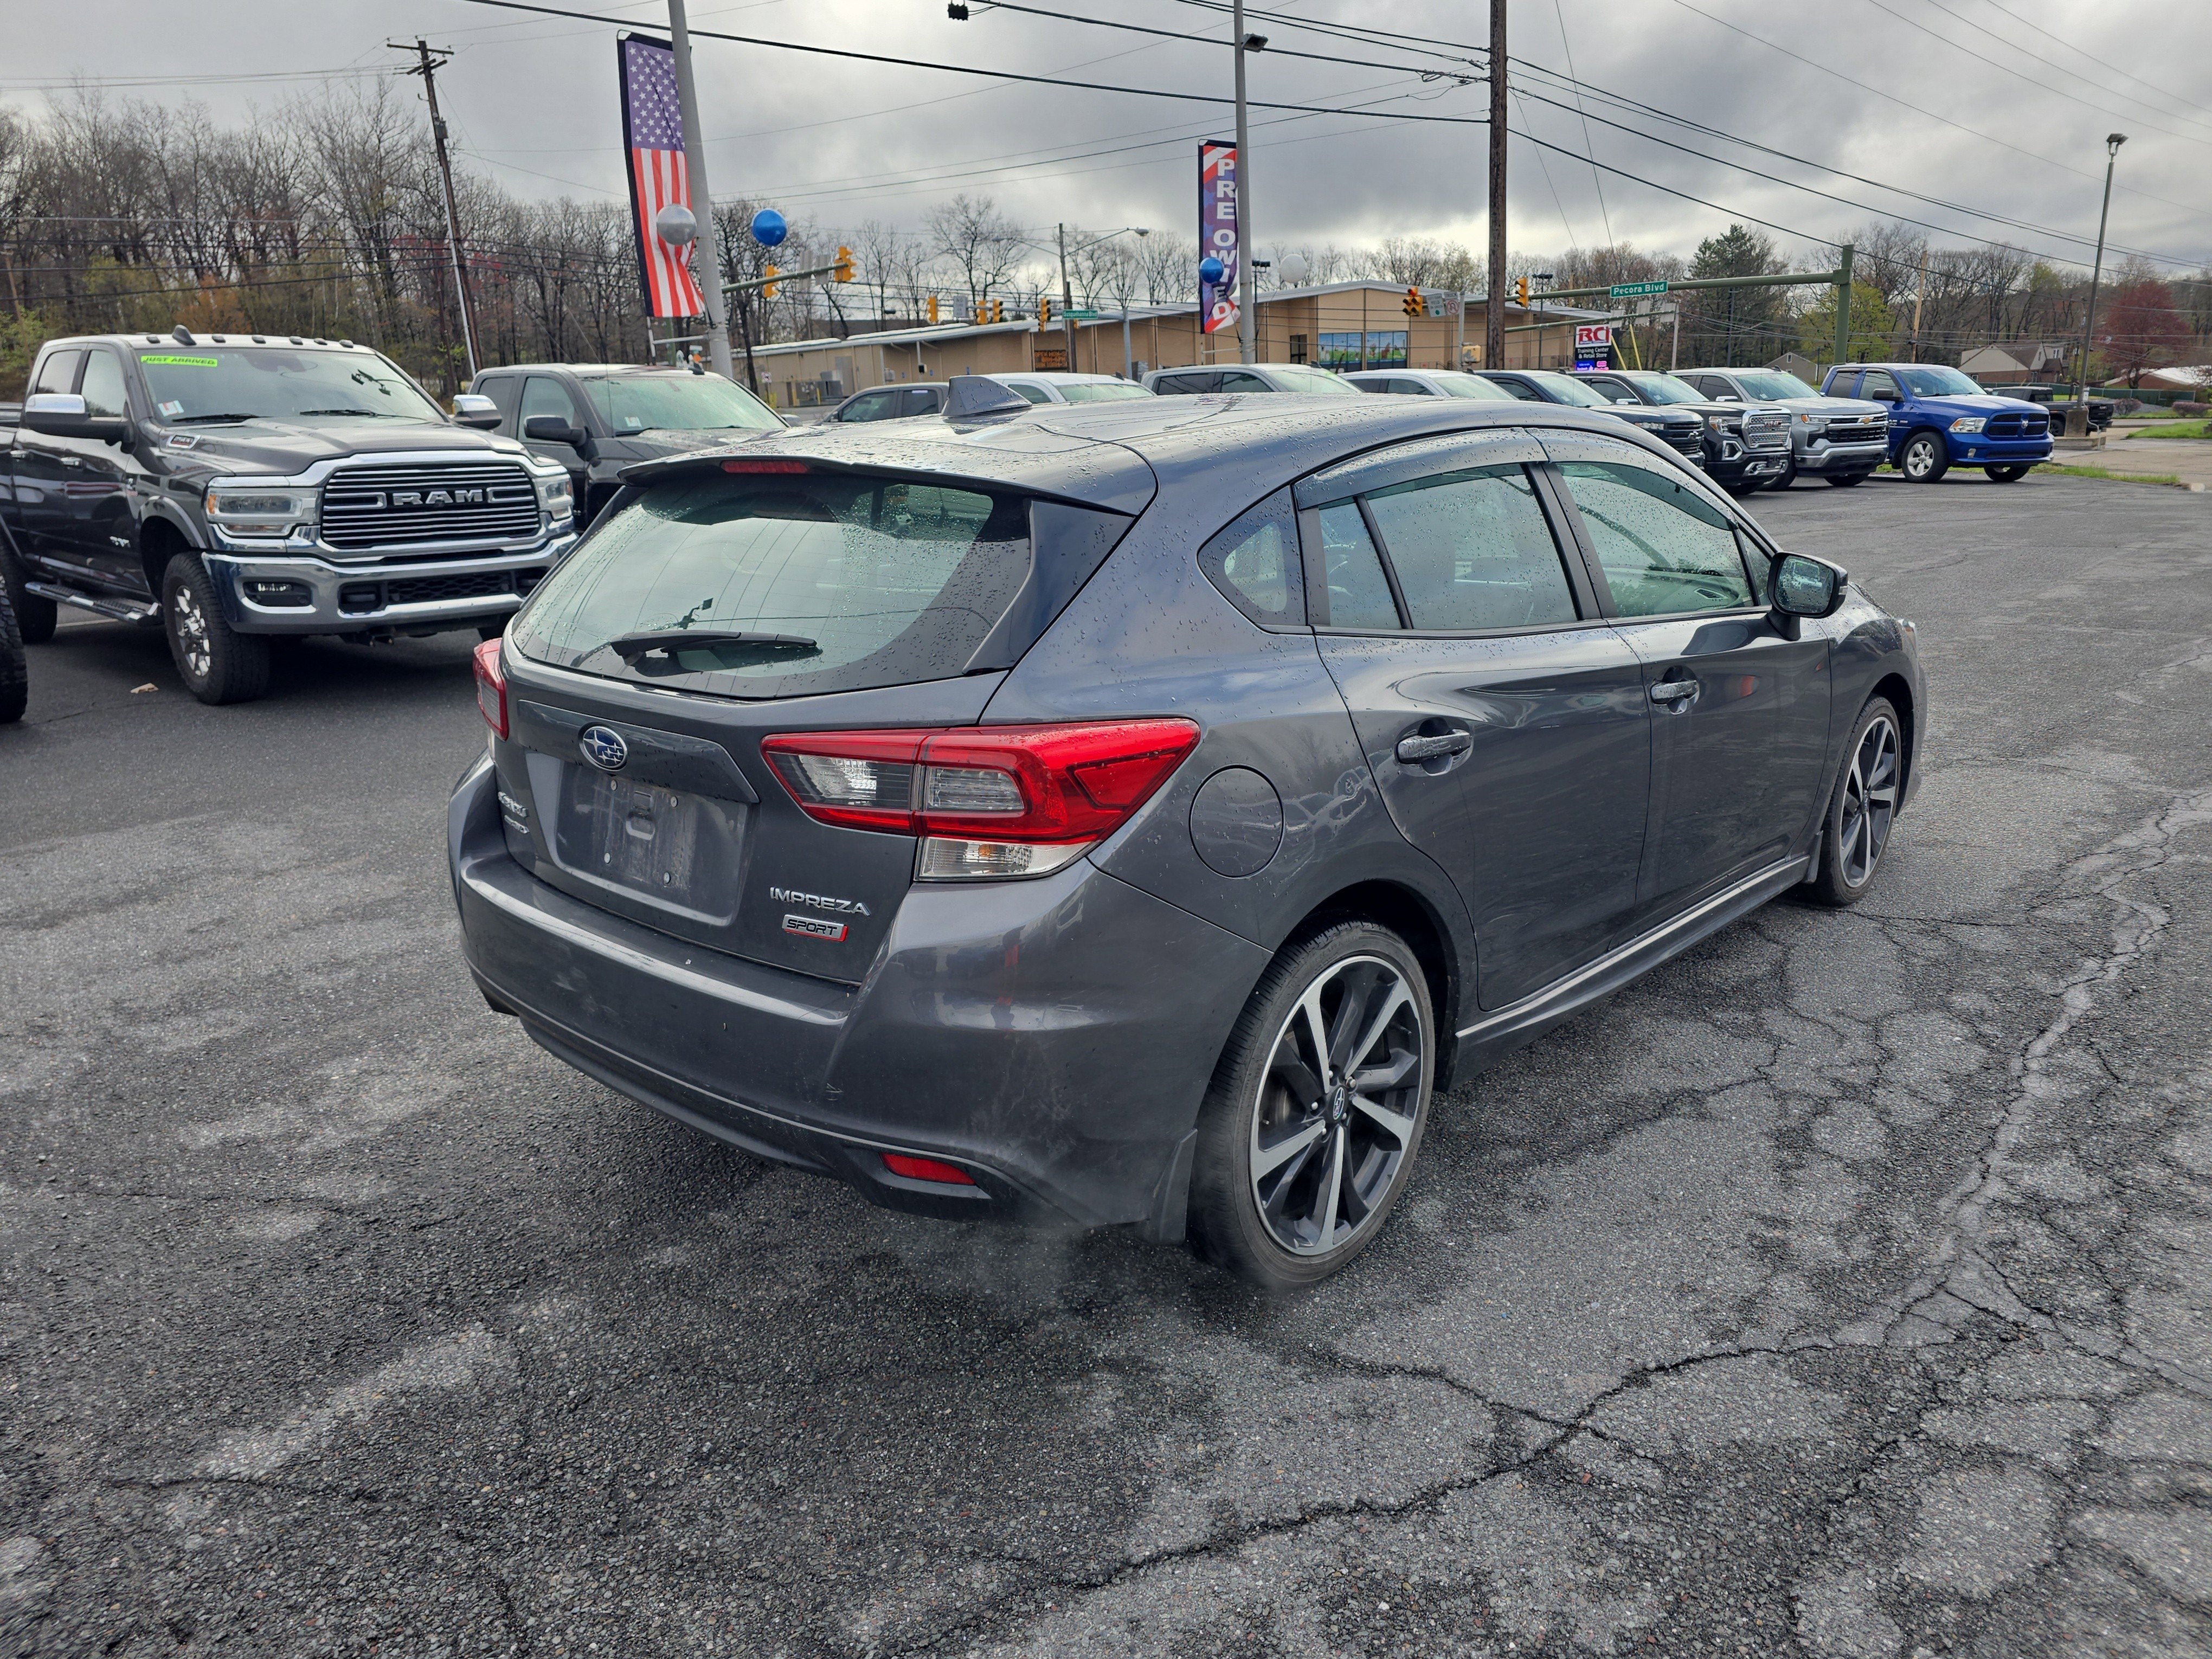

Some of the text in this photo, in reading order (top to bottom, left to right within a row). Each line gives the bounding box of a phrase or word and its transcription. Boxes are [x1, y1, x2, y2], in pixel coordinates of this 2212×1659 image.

[1217, 158, 1236, 219] PRE
[1613, 283, 1664, 295] Pecora Blvd
[393, 490, 483, 506] RAM
[770, 886, 871, 916] IMPREZA
[787, 918, 838, 935] SPORT
